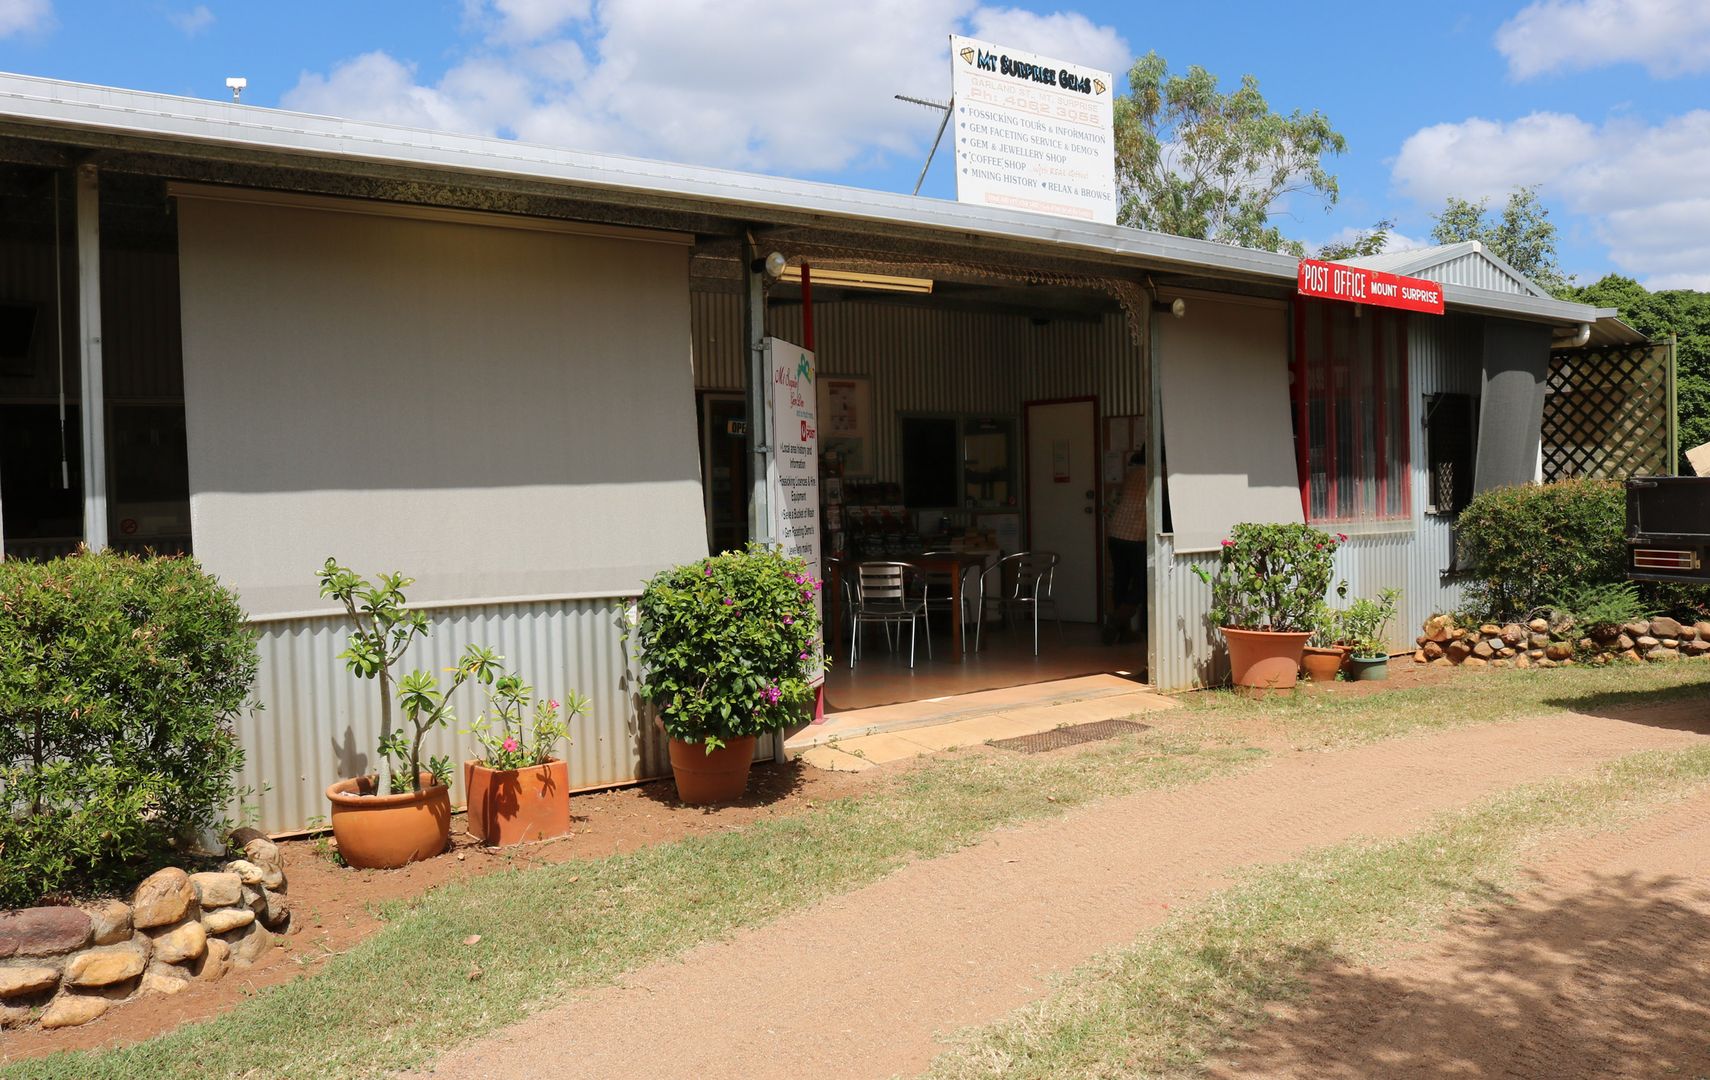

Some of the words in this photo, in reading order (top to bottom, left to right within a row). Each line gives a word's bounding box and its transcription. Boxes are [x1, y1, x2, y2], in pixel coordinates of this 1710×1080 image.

[971, 77, 1016, 95] GARLAND
[1057, 96, 1099, 113] SURPRISE
[969, 107, 1018, 126] FOSSICKING
[1020, 119, 1046, 132] TOURS
[1055, 126, 1106, 144] INFORMATION
[970, 123, 988, 134] GEM
[990, 127, 1028, 142] FACETING
[1030, 135, 1062, 150] SERVICE
[1064, 143, 1069, 151] &
[1071, 143, 1099, 157] DEMO'S
[970, 138, 988, 150] GEM
[1000, 143, 1043, 159] JEWELLERY
[1046, 152, 1067, 164] SHOP
[970, 153, 1002, 166] COFFEE
[1004, 159, 1026, 171] SHOP
[971, 168, 1001, 182] MINING
[1003, 174, 1037, 188] HISTORY
[1048, 181, 1072, 194] RELAX
[1081, 187, 1112, 201] BROWSE
[1305, 264, 1329, 293] POST
[1334, 269, 1366, 299] OFFICE
[1371, 281, 1397, 298] MOUNT
[1402, 286, 1439, 305] SURPRISE
